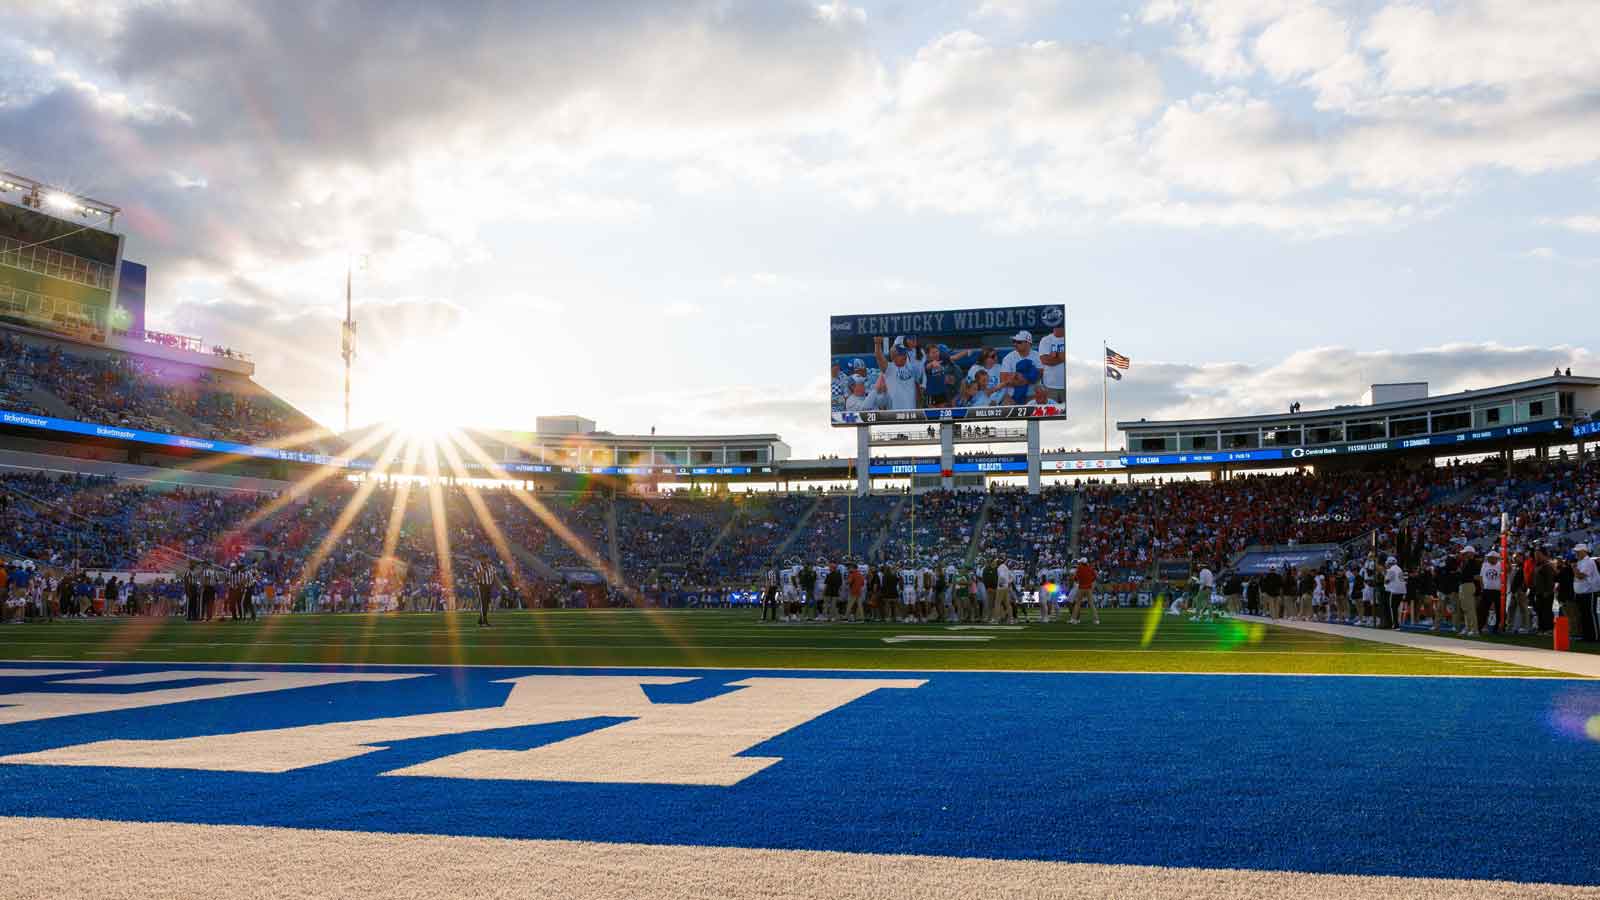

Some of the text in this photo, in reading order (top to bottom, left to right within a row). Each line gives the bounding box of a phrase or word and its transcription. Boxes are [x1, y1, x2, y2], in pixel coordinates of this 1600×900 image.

[857, 313, 945, 335] KENTUCKY
[953, 308, 1037, 330] WILDCATS
[867, 412, 877, 421] 20
[975, 409, 988, 417] BALL
[1017, 407, 1028, 417] 27
[4, 414, 48, 426] ticketmaster
[96, 427, 136, 439] ticketmaster
[1367, 442, 1388, 450] LEADERS
[892, 463, 1002, 473] KENTUCKY WILDCATS
